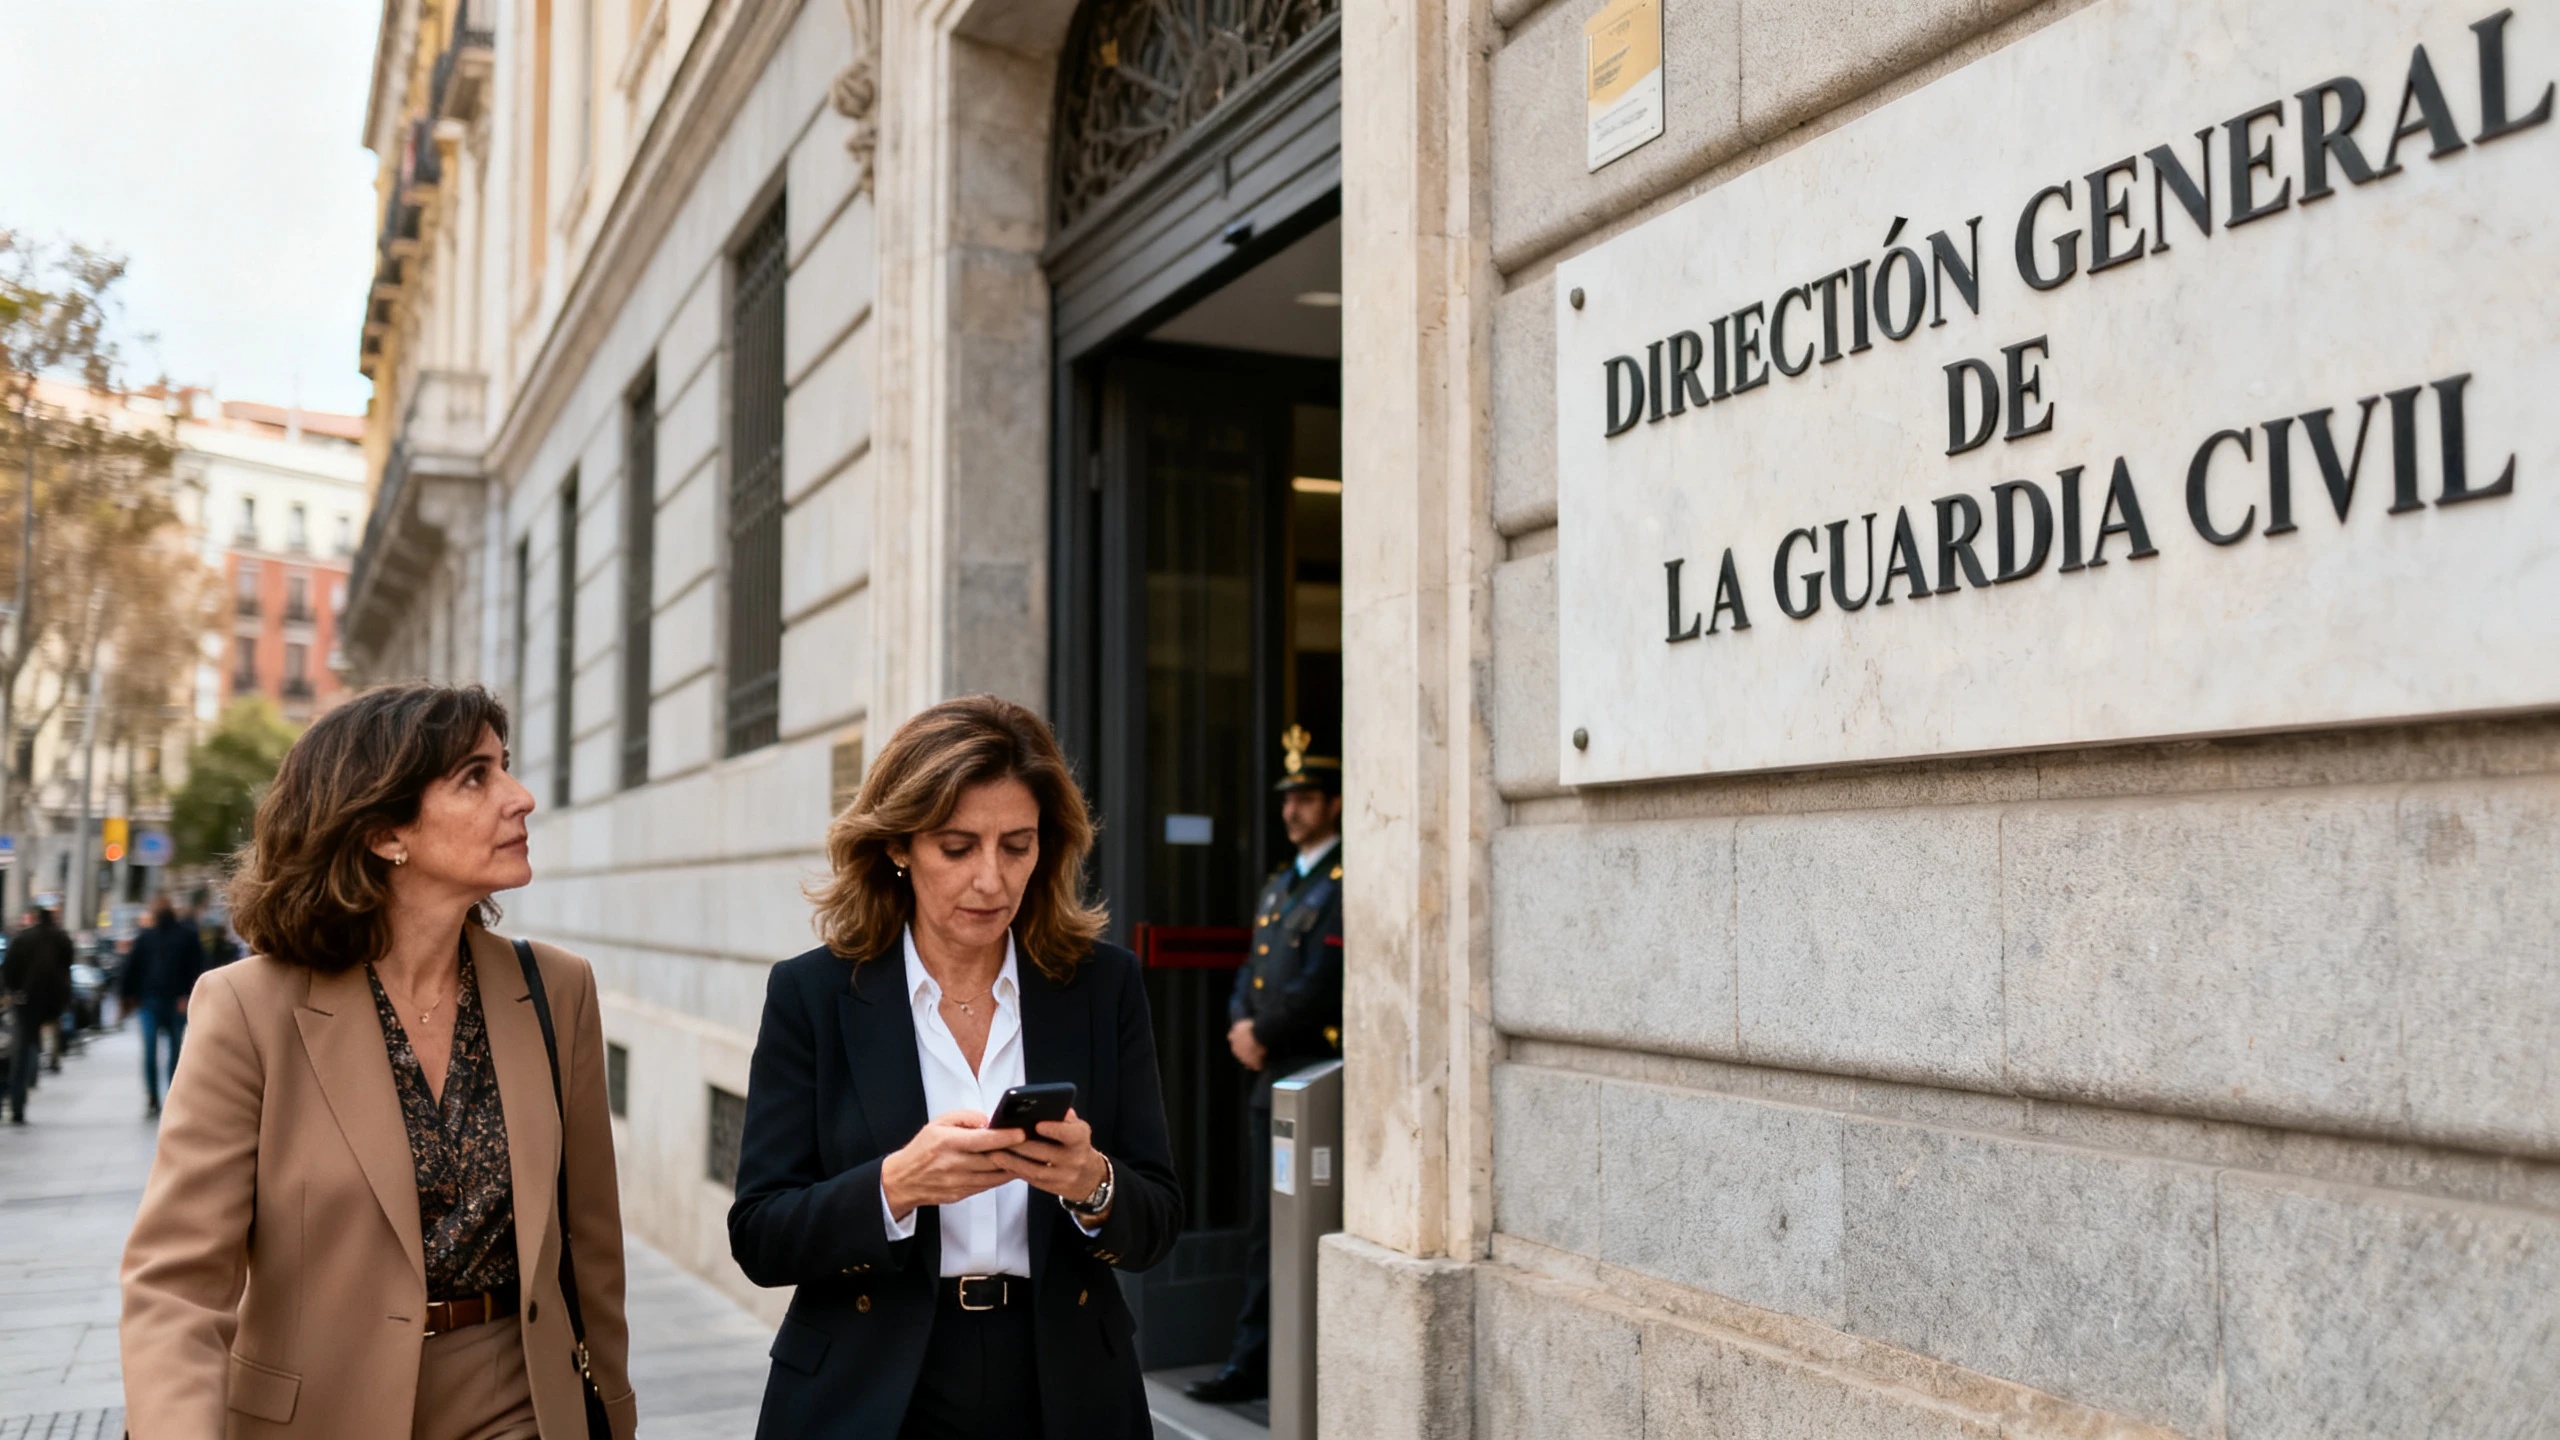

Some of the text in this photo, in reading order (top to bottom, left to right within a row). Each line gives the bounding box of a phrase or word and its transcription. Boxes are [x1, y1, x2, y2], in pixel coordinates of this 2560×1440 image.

[1603, 8, 2556, 440] DIRIECTIÓN GENERAL
[1663, 372, 2516, 645] LA GUARDIA CIVIL
[1942, 334, 2055, 459] DE
